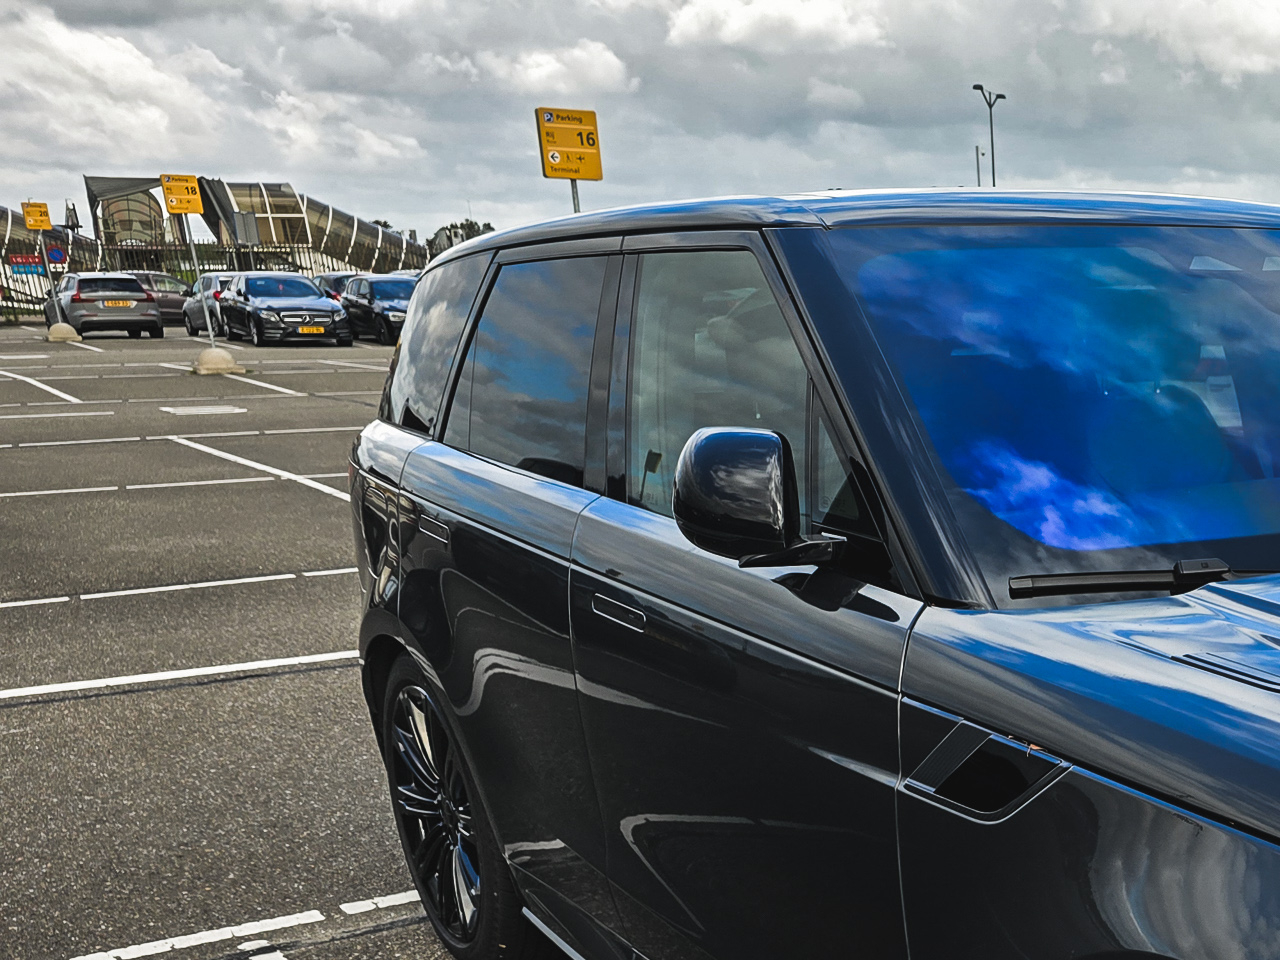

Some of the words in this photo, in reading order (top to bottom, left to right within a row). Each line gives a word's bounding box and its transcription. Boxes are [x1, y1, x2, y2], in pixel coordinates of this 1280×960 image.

[556, 114, 583, 124] Parking
[576, 131, 596, 147] 16
[550, 166, 580, 174] Terminal
[185, 186, 197, 195] 18
